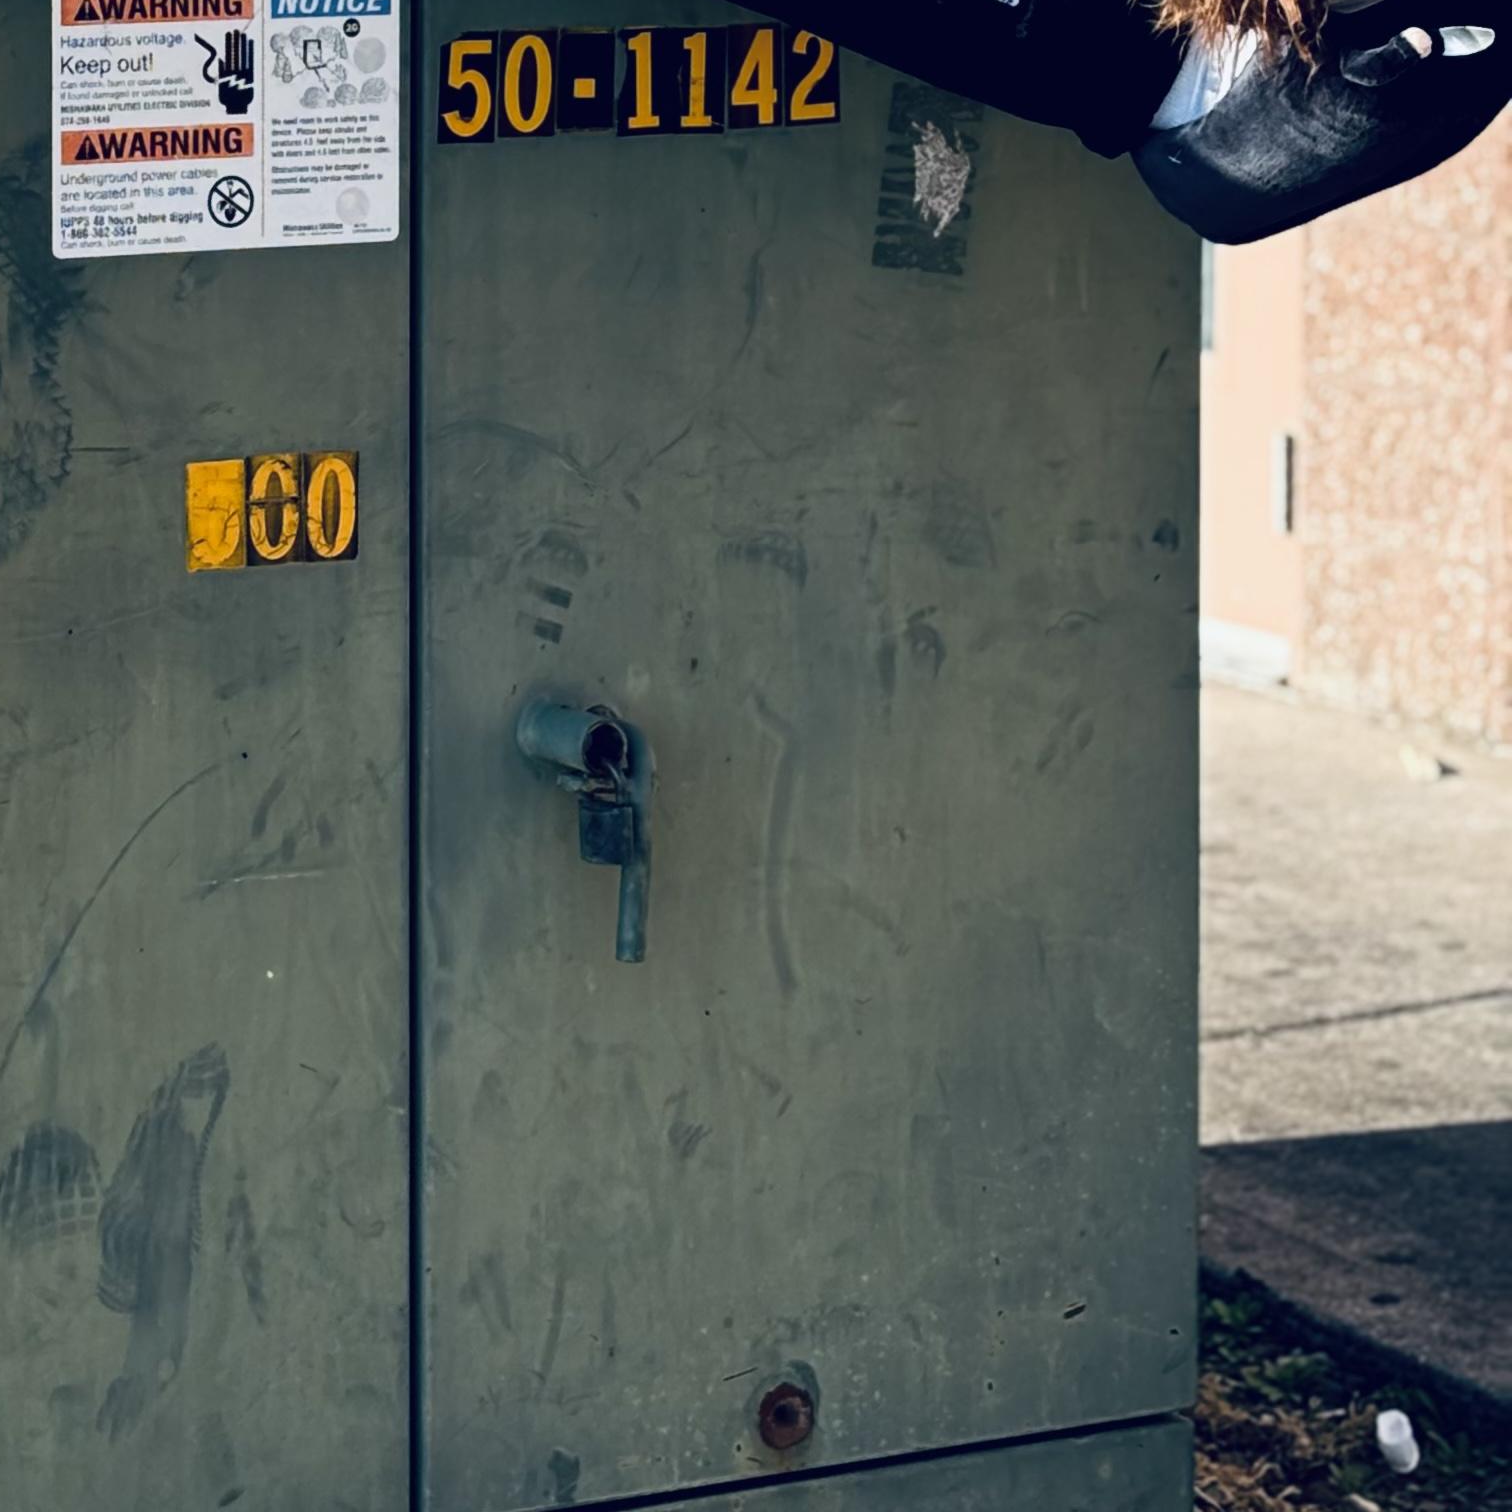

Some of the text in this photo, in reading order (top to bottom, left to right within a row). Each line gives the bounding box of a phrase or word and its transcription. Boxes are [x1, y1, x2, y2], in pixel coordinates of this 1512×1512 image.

[61, 35, 132, 48] Hazardous
[61, 53, 153, 77] Keep out!
[442, 28, 836, 137] 50-1142
[98, 128, 243, 160] WARNING
[61, 168, 218, 186] Underground power cables
[61, 192, 81, 201] are
[84, 188, 126, 200] located
[130, 189, 140, 197] in
[144, 186, 164, 197] this
[108, 215, 134, 225] hours
[137, 213, 166, 224] before
[170, 212, 203, 223] digging
